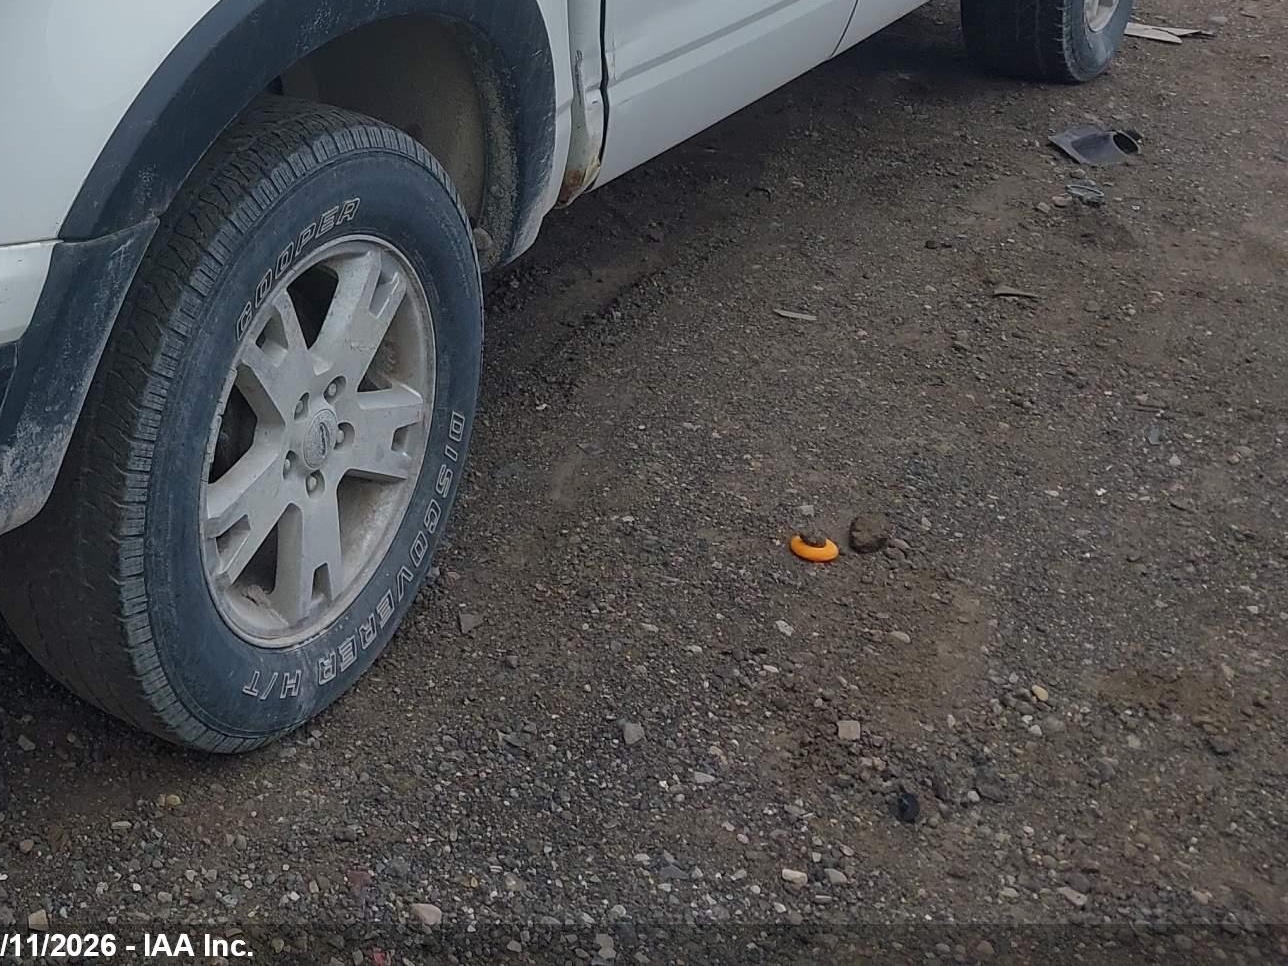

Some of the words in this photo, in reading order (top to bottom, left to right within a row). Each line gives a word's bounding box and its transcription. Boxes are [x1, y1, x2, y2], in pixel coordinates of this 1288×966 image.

[236, 197, 361, 341] COOPER
[317, 410, 465, 685] DISCOVERER
[242, 669, 302, 700] H/T
